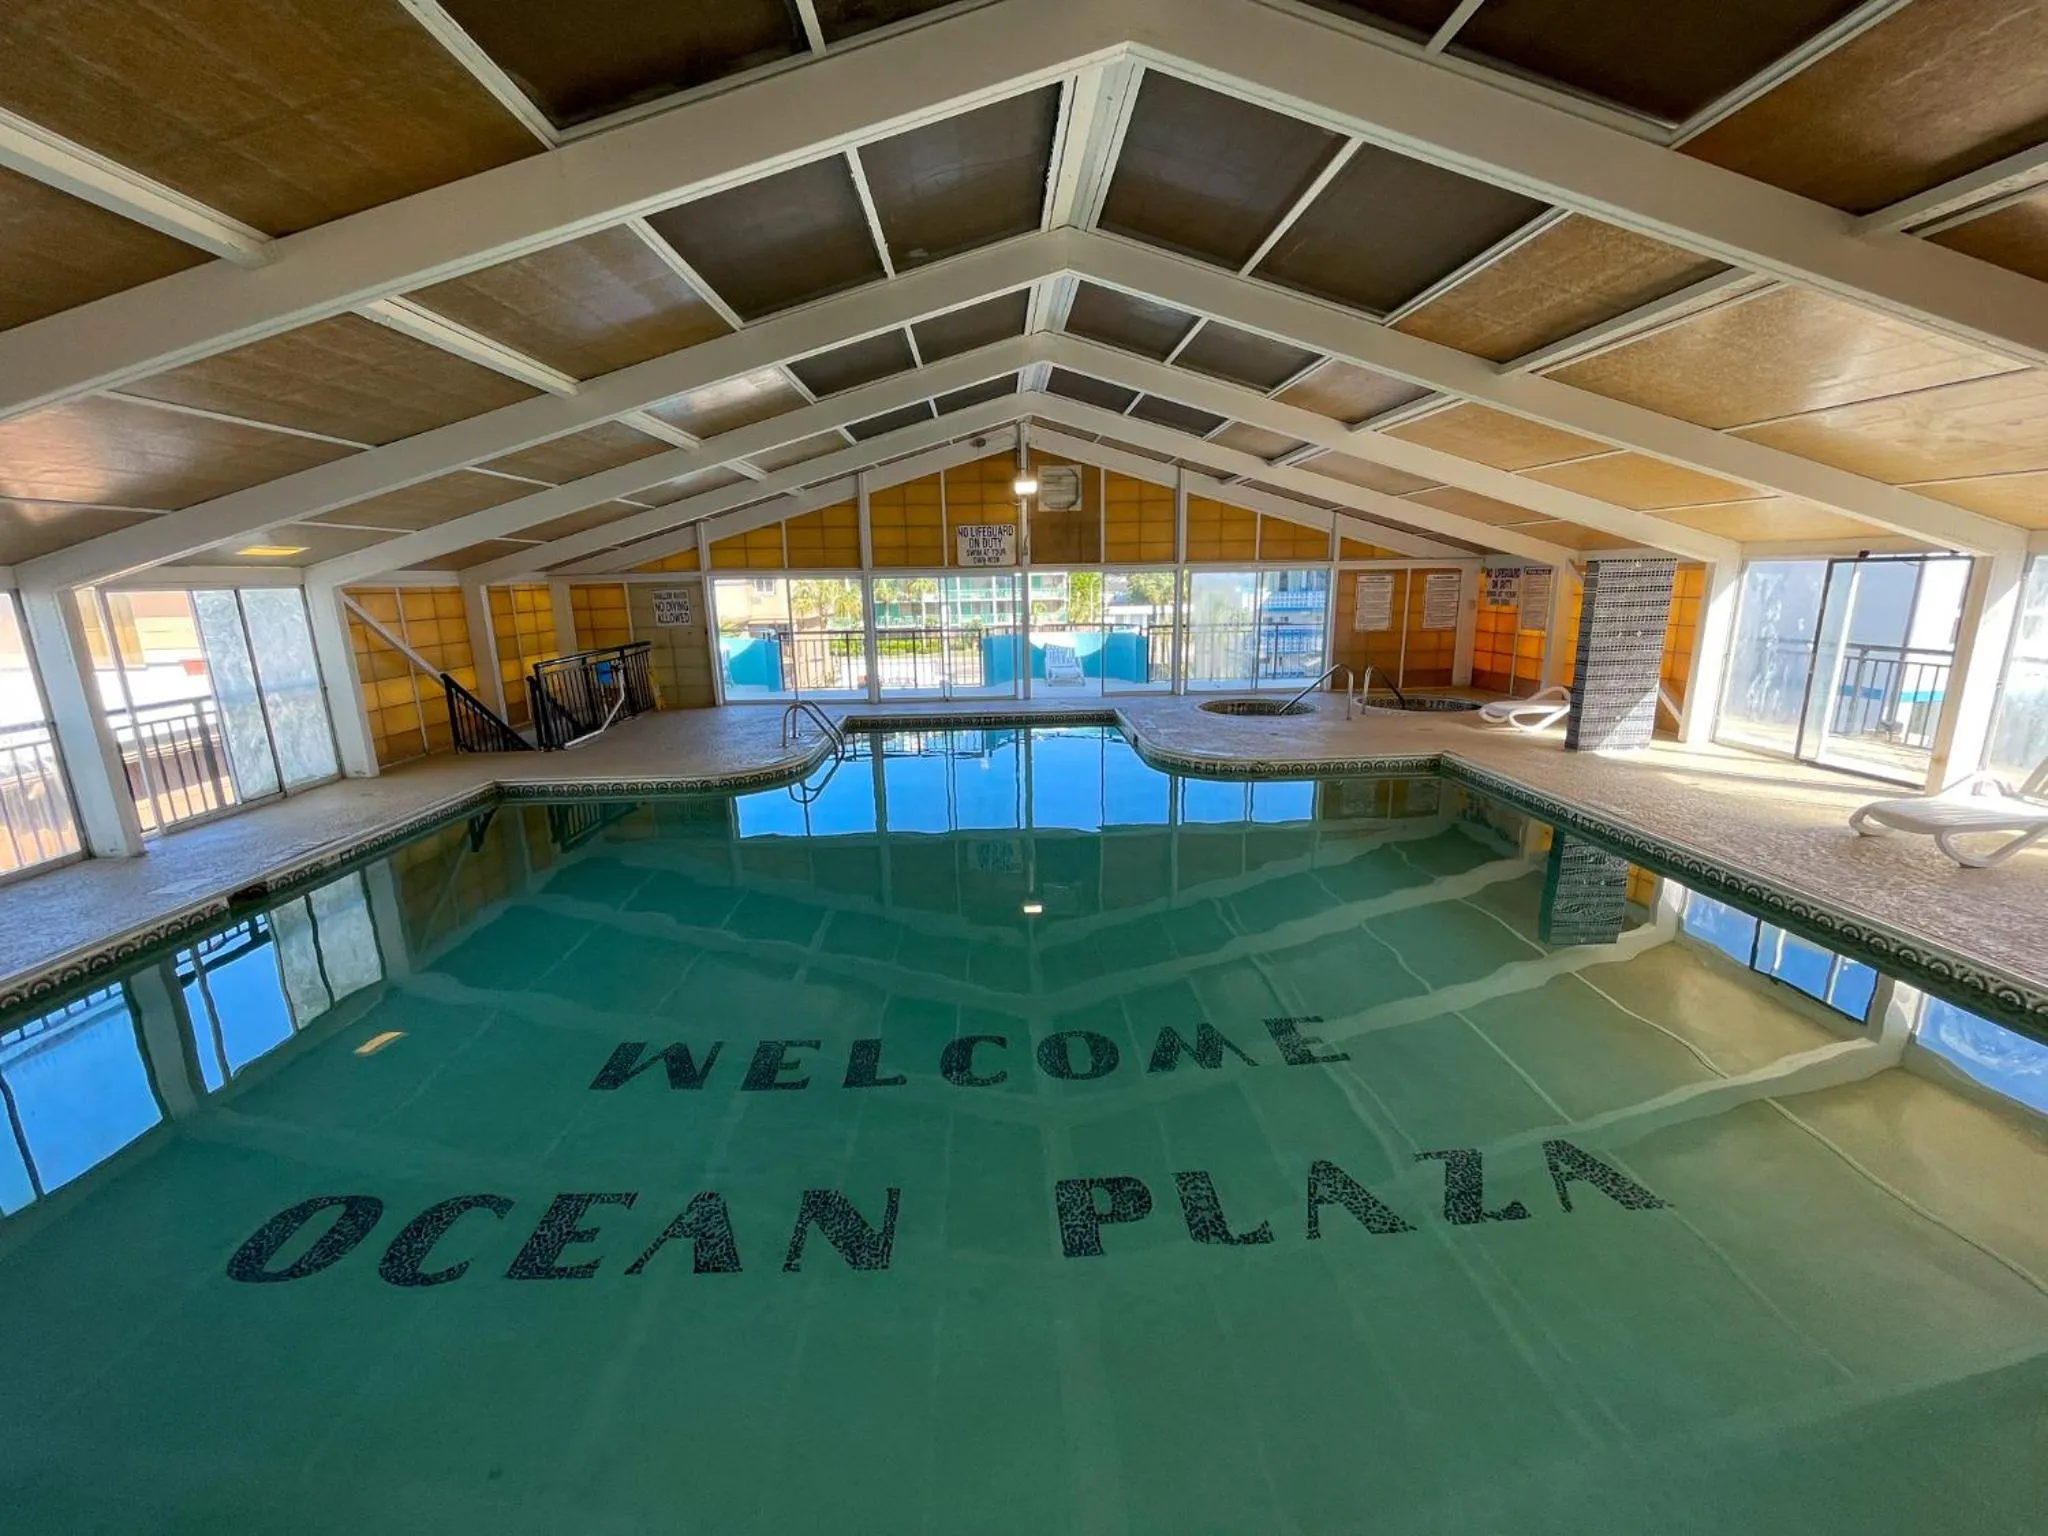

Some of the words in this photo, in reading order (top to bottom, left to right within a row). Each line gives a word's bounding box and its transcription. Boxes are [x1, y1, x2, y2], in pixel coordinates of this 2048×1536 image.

[959, 526, 969, 537] NO
[970, 525, 1014, 537] LIFEGUARD
[969, 537, 980, 548] ON
[982, 537, 1003, 548] DUTY
[655, 601, 665, 612] NO
[666, 600, 689, 612] DIVING
[657, 612, 689, 624] ALLOWED
[588, 1015, 1352, 1092] WELCOME
[226, 1187, 902, 1287] OCEAN
[1055, 1139, 1671, 1258] PLAZA
